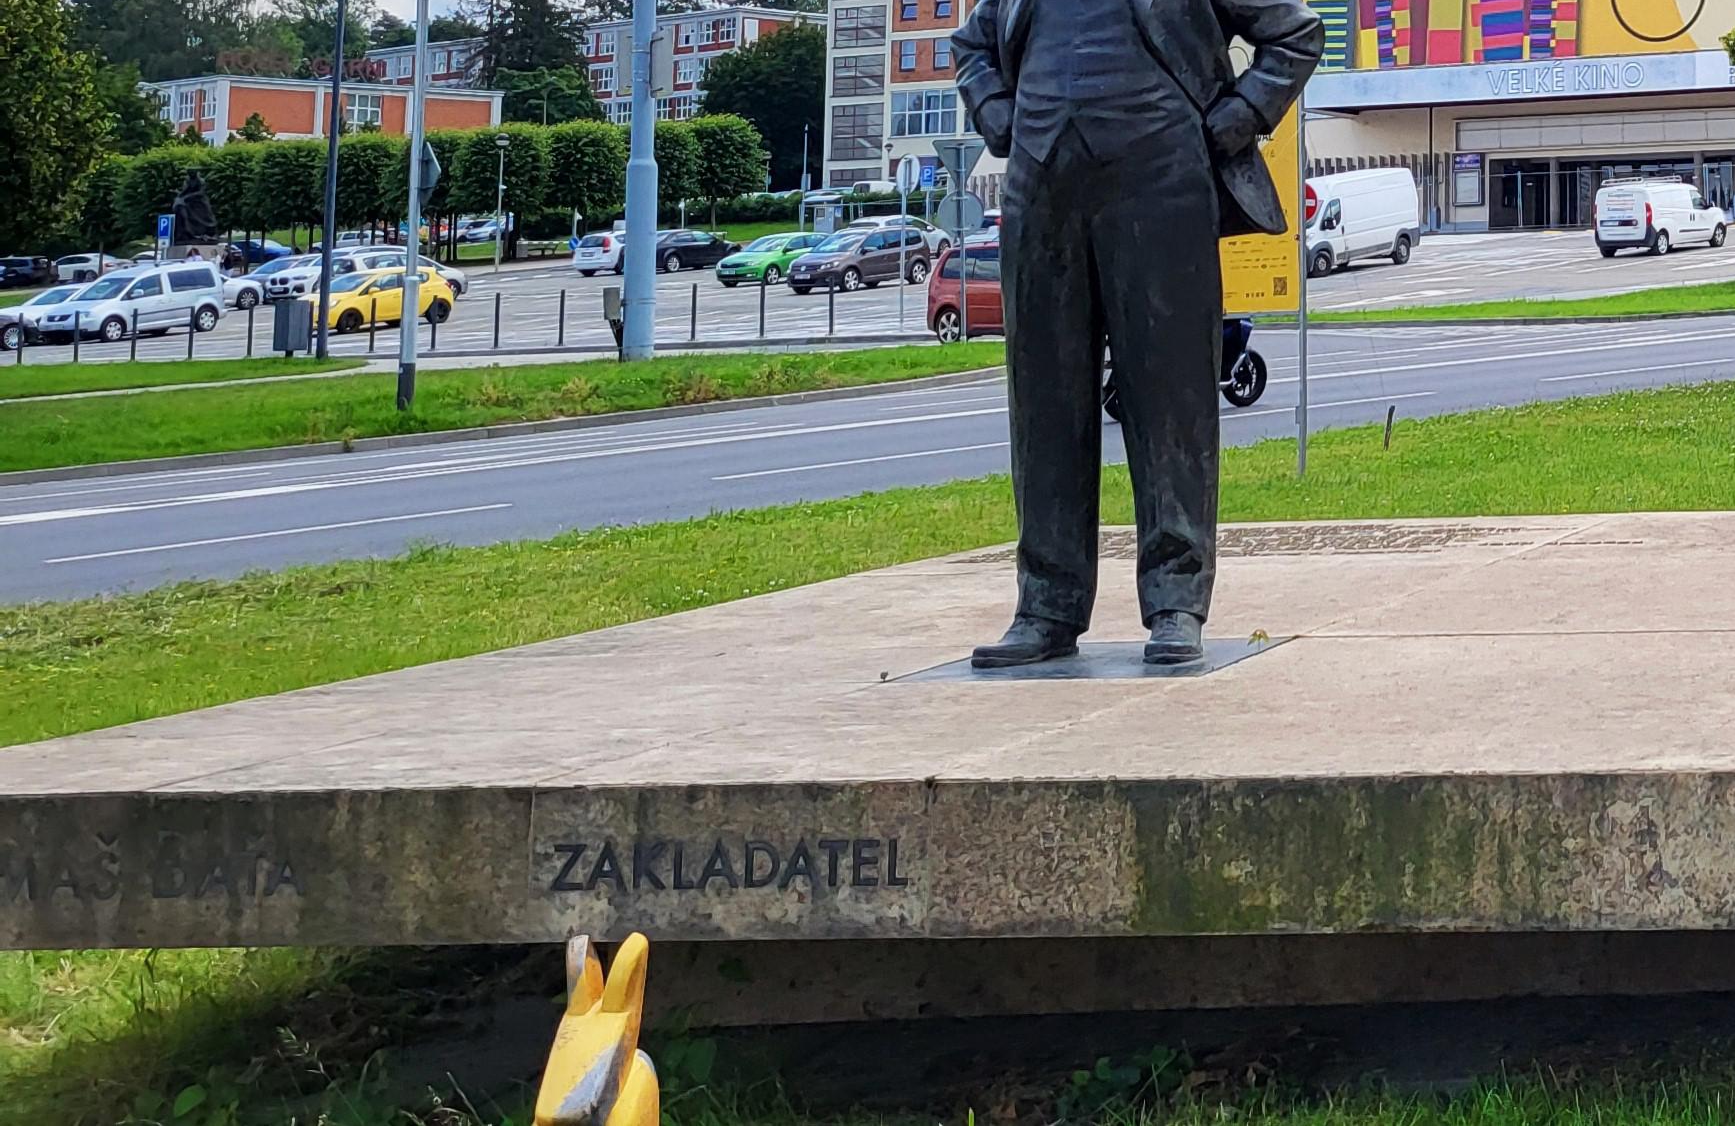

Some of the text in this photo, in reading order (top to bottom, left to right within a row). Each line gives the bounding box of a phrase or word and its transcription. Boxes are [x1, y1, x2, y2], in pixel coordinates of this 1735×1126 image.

[1487, 61, 1644, 96] VELKÉ KINO
[551, 837, 909, 892] ZAKLADATEL
